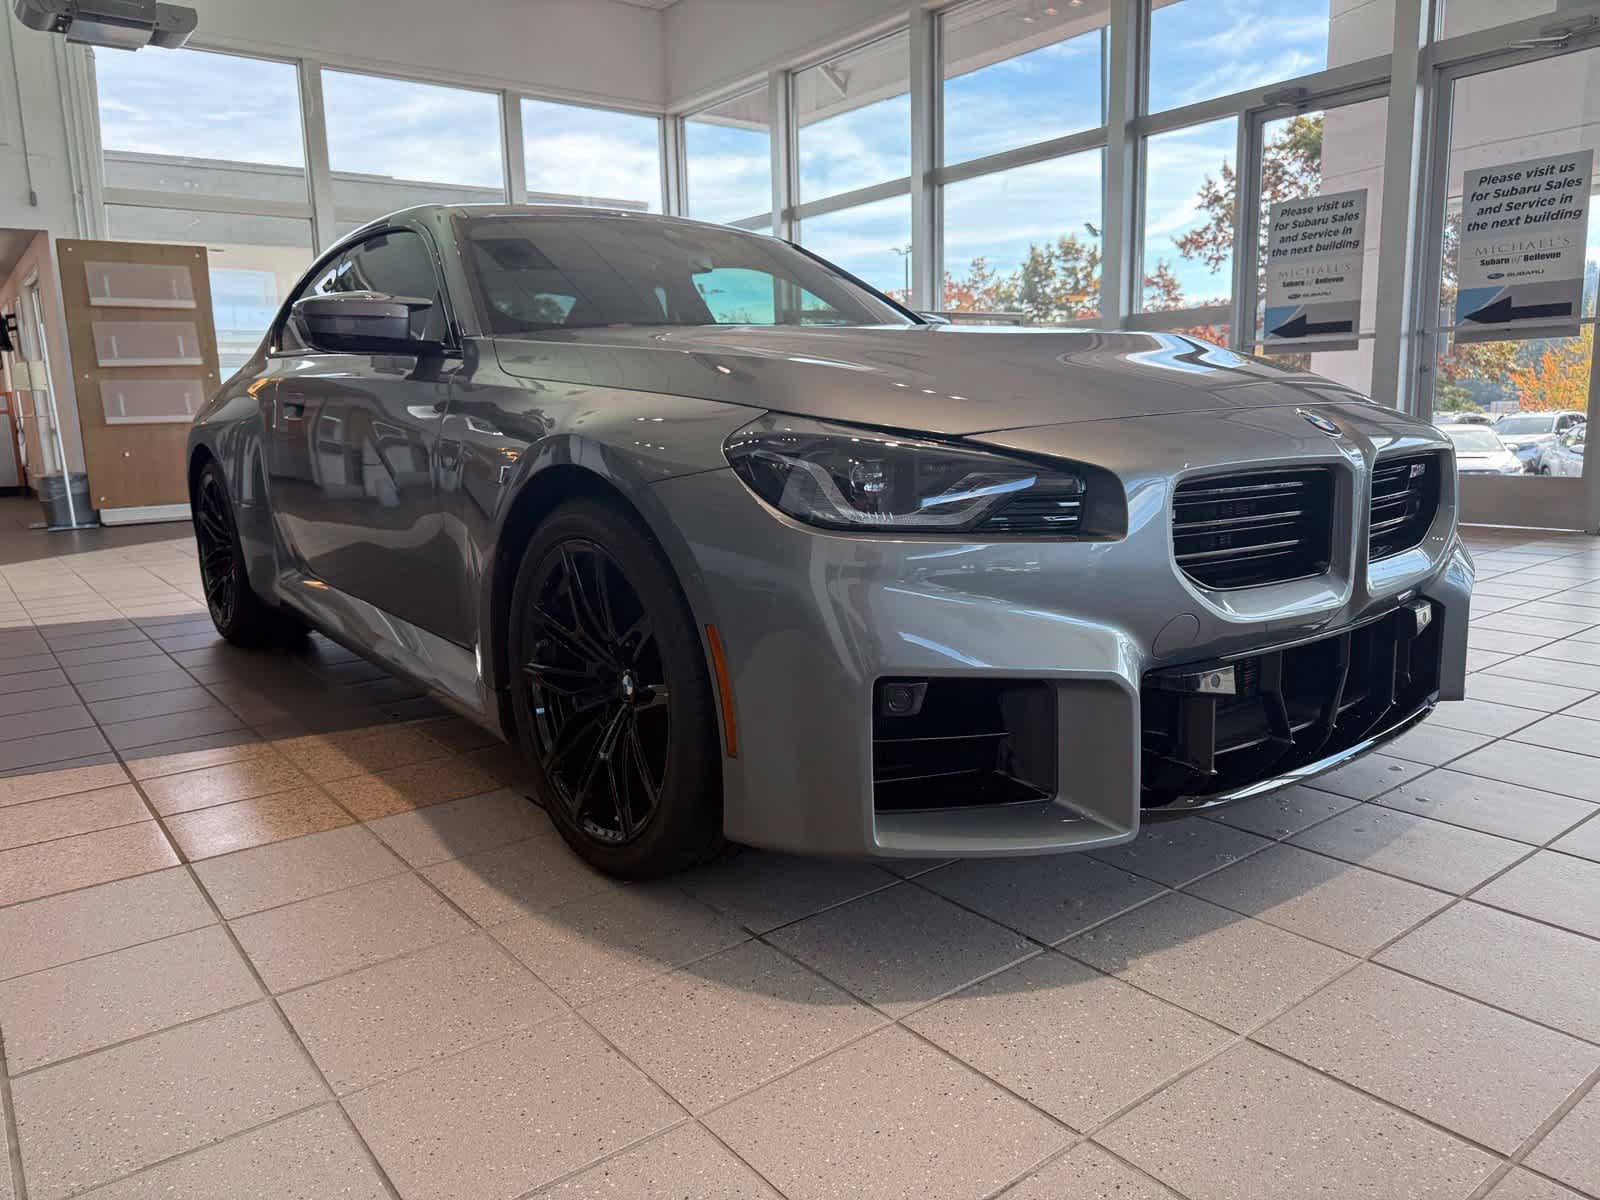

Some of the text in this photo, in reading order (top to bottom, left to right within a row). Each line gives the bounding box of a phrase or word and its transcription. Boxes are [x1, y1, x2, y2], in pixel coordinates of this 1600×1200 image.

[1478, 163, 1576, 186] Please visit us
[1470, 178, 1583, 203] for Subaru Sales
[1280, 200, 1354, 217] Please visit us
[1476, 194, 1573, 216] and Service in
[1274, 212, 1360, 232] for Subaru Sales
[1467, 208, 1583, 232] the next building
[1280, 226, 1352, 244] and Service in
[1272, 240, 1360, 256] the next building
[1480, 258, 1510, 266] Subaru
[1523, 251, 1562, 262] Bellevue
